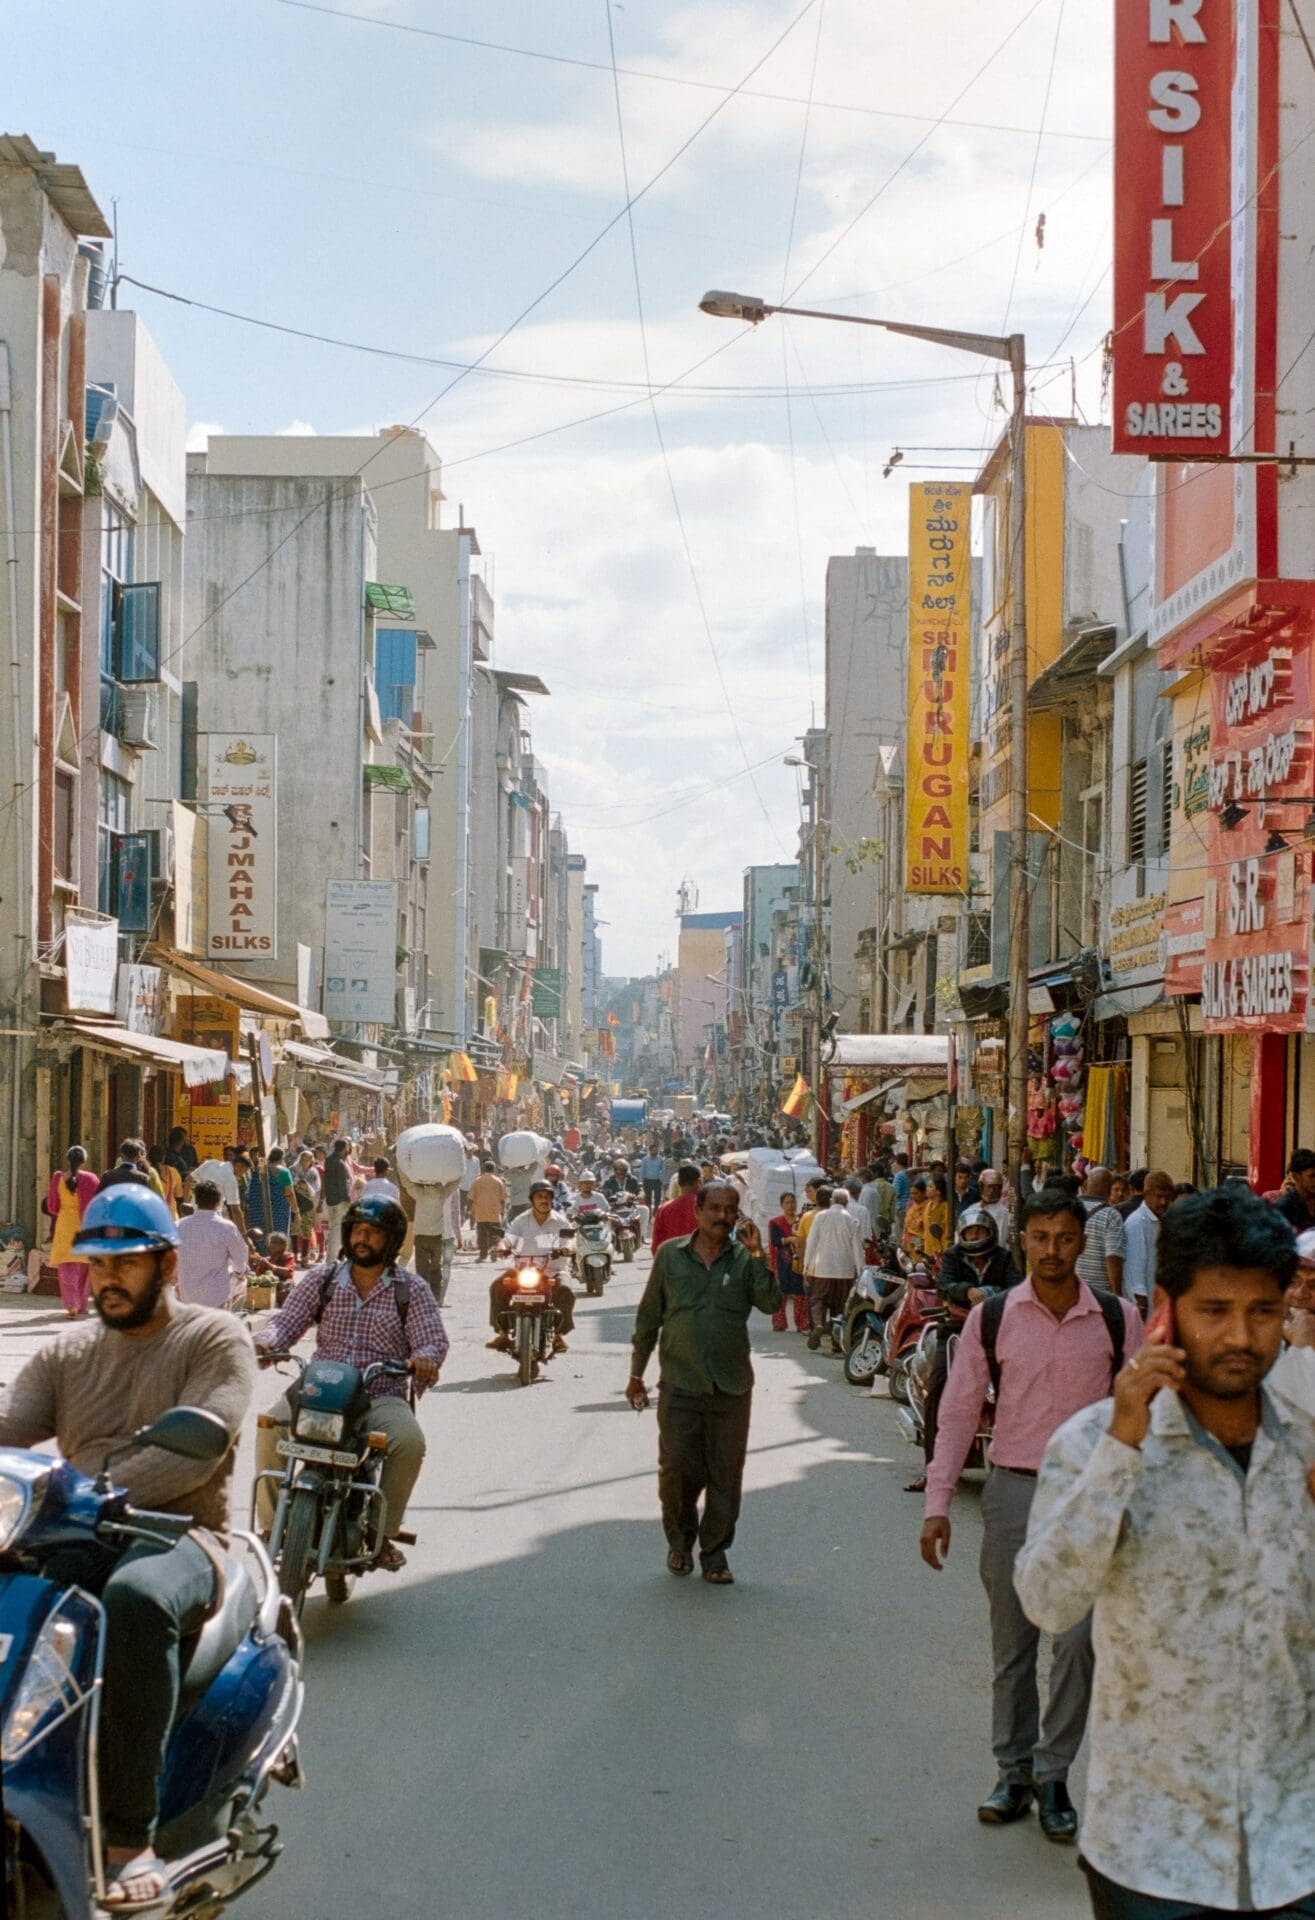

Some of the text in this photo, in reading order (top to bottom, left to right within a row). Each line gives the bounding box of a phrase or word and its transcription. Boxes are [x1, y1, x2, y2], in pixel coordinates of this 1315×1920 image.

[1144, 71, 1207, 355] SILK
[1162, 362, 1189, 397] &
[1127, 403, 1222, 438] SAREES
[922, 630, 958, 647] SRI
[922, 649, 957, 861] MURUGAN
[911, 866, 962, 886] SILKS
[1228, 858, 1265, 935] S.R.
[211, 935, 272, 950] SILKS
[1202, 960, 1227, 1018] SILK
[1242, 952, 1293, 1016] SAREES
